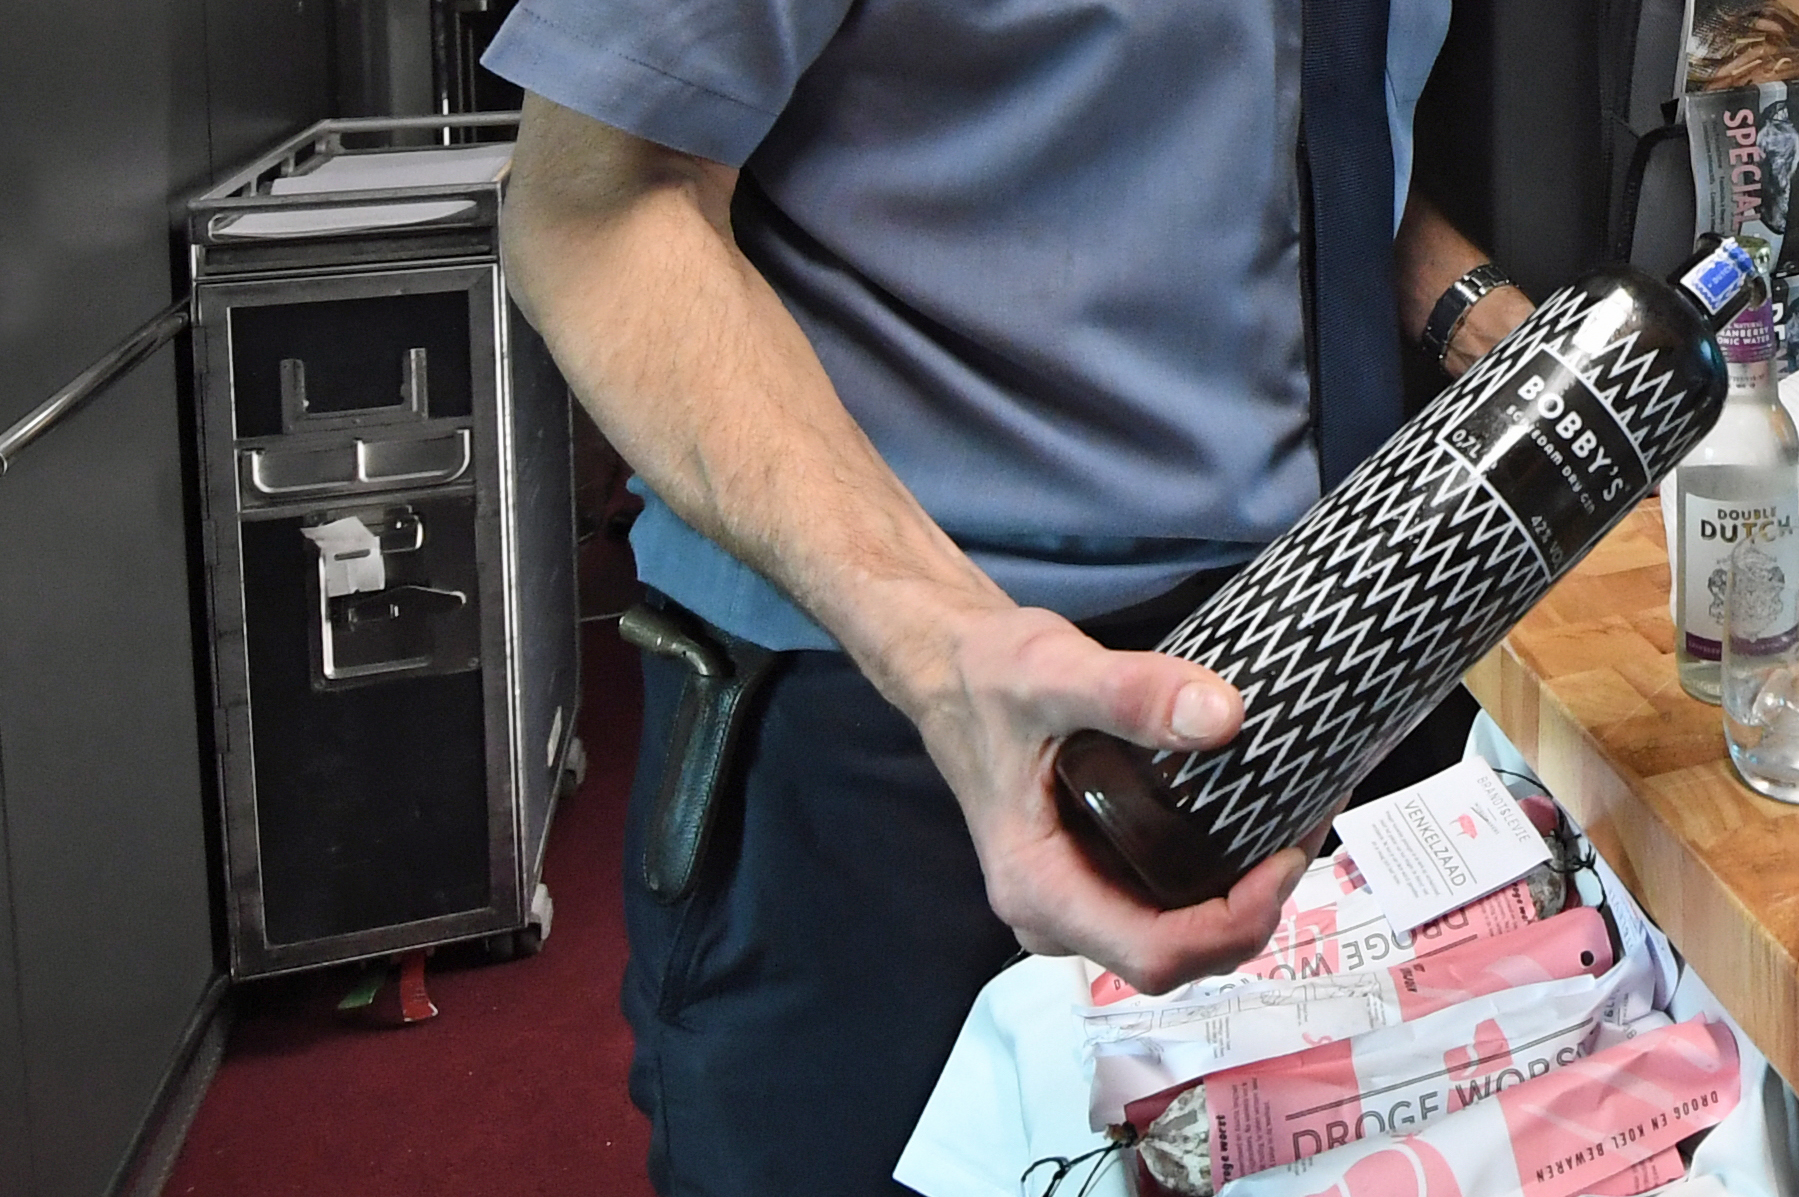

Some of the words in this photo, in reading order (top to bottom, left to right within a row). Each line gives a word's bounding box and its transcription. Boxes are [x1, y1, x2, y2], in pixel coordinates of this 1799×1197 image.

[1723, 108, 1761, 227] SPÉCIAL
[1743, 336, 1770, 345] WATER
[1451, 428, 1483, 460] 0,7L
[1517, 375, 1625, 502] BOBBY'S
[1561, 466, 1581, 494] DRY
[1717, 507, 1777, 521] DOUBLE
[1700, 515, 1794, 544] DUTCH
[1476, 775, 1532, 842] BRANDTSLEVIE
[1403, 799, 1468, 889] VENKELZAAD
[1673, 1090, 1719, 1120] DROOG
[1611, 1124, 1645, 1149] KOEL
[1652, 1113, 1668, 1131] EN
[1535, 1142, 1605, 1183] BEWAREN
